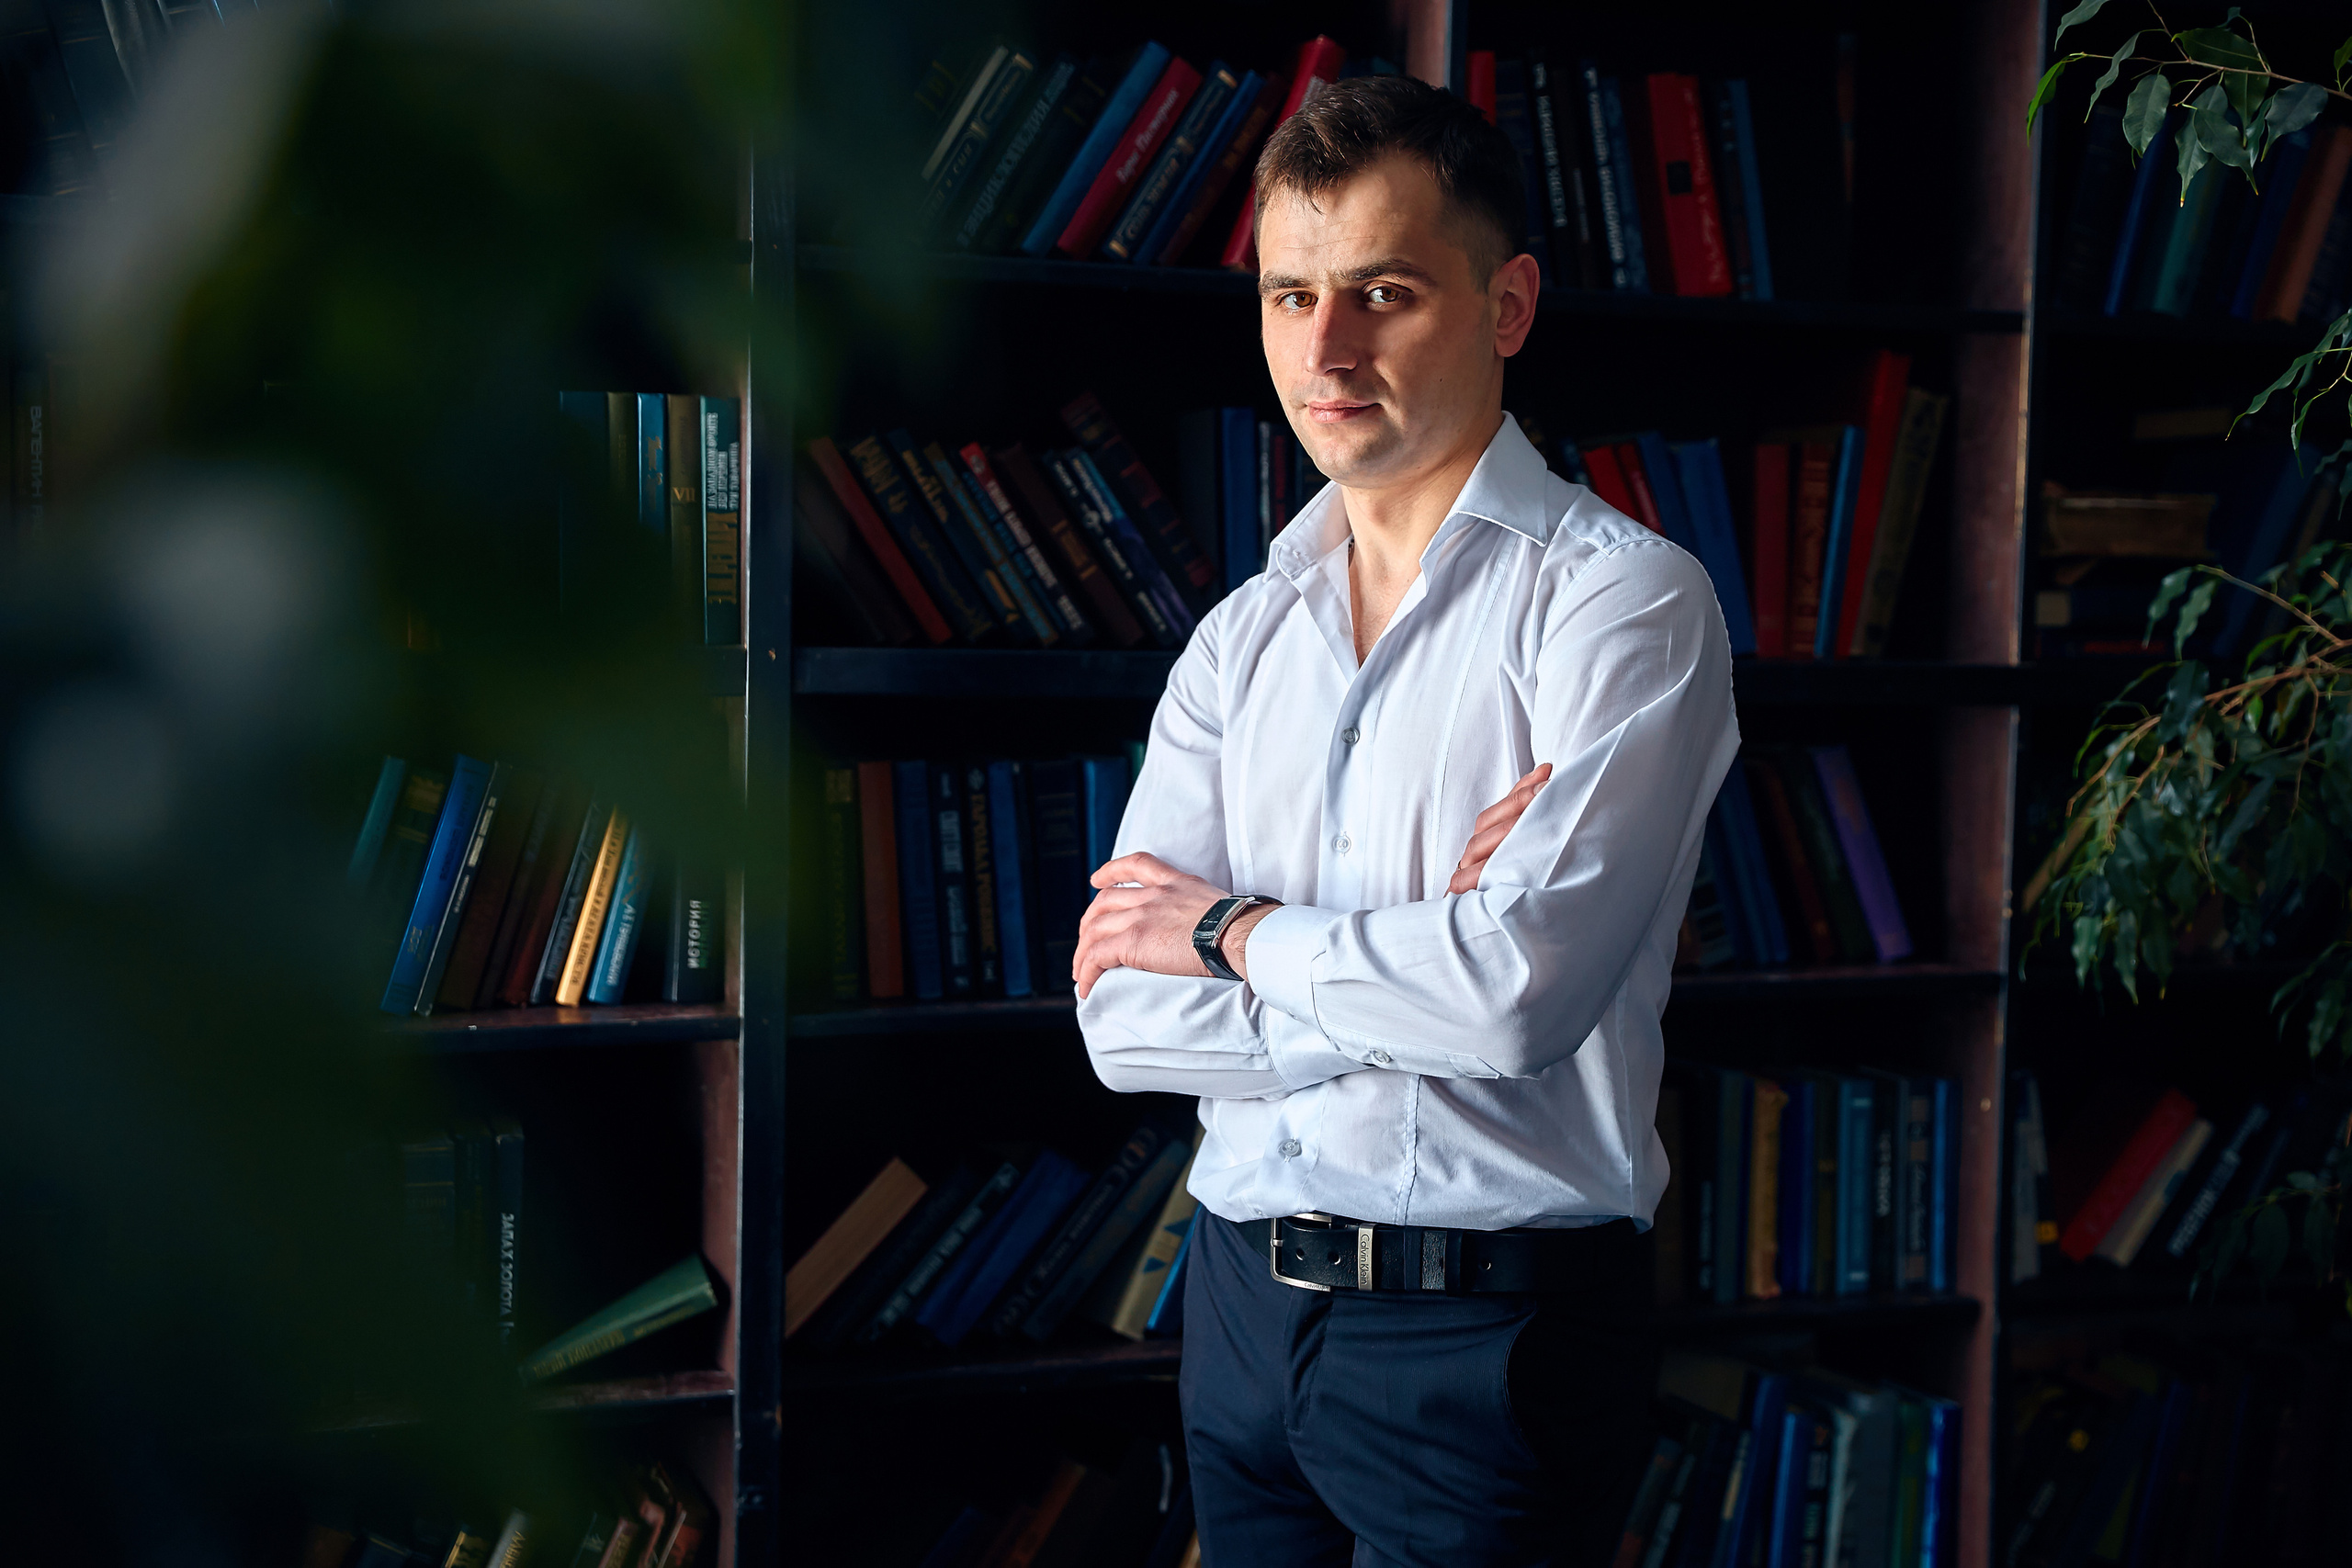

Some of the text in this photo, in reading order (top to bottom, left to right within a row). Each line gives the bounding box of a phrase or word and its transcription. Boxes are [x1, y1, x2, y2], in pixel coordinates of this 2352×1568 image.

[673, 487, 695, 502] VII
[687, 899, 701, 969] ИСТОРИЯ
[499, 1213, 515, 1316] ЗАПАХ ЗОЛОТА
[1360, 1234, 1370, 1285] Calvin Klein
